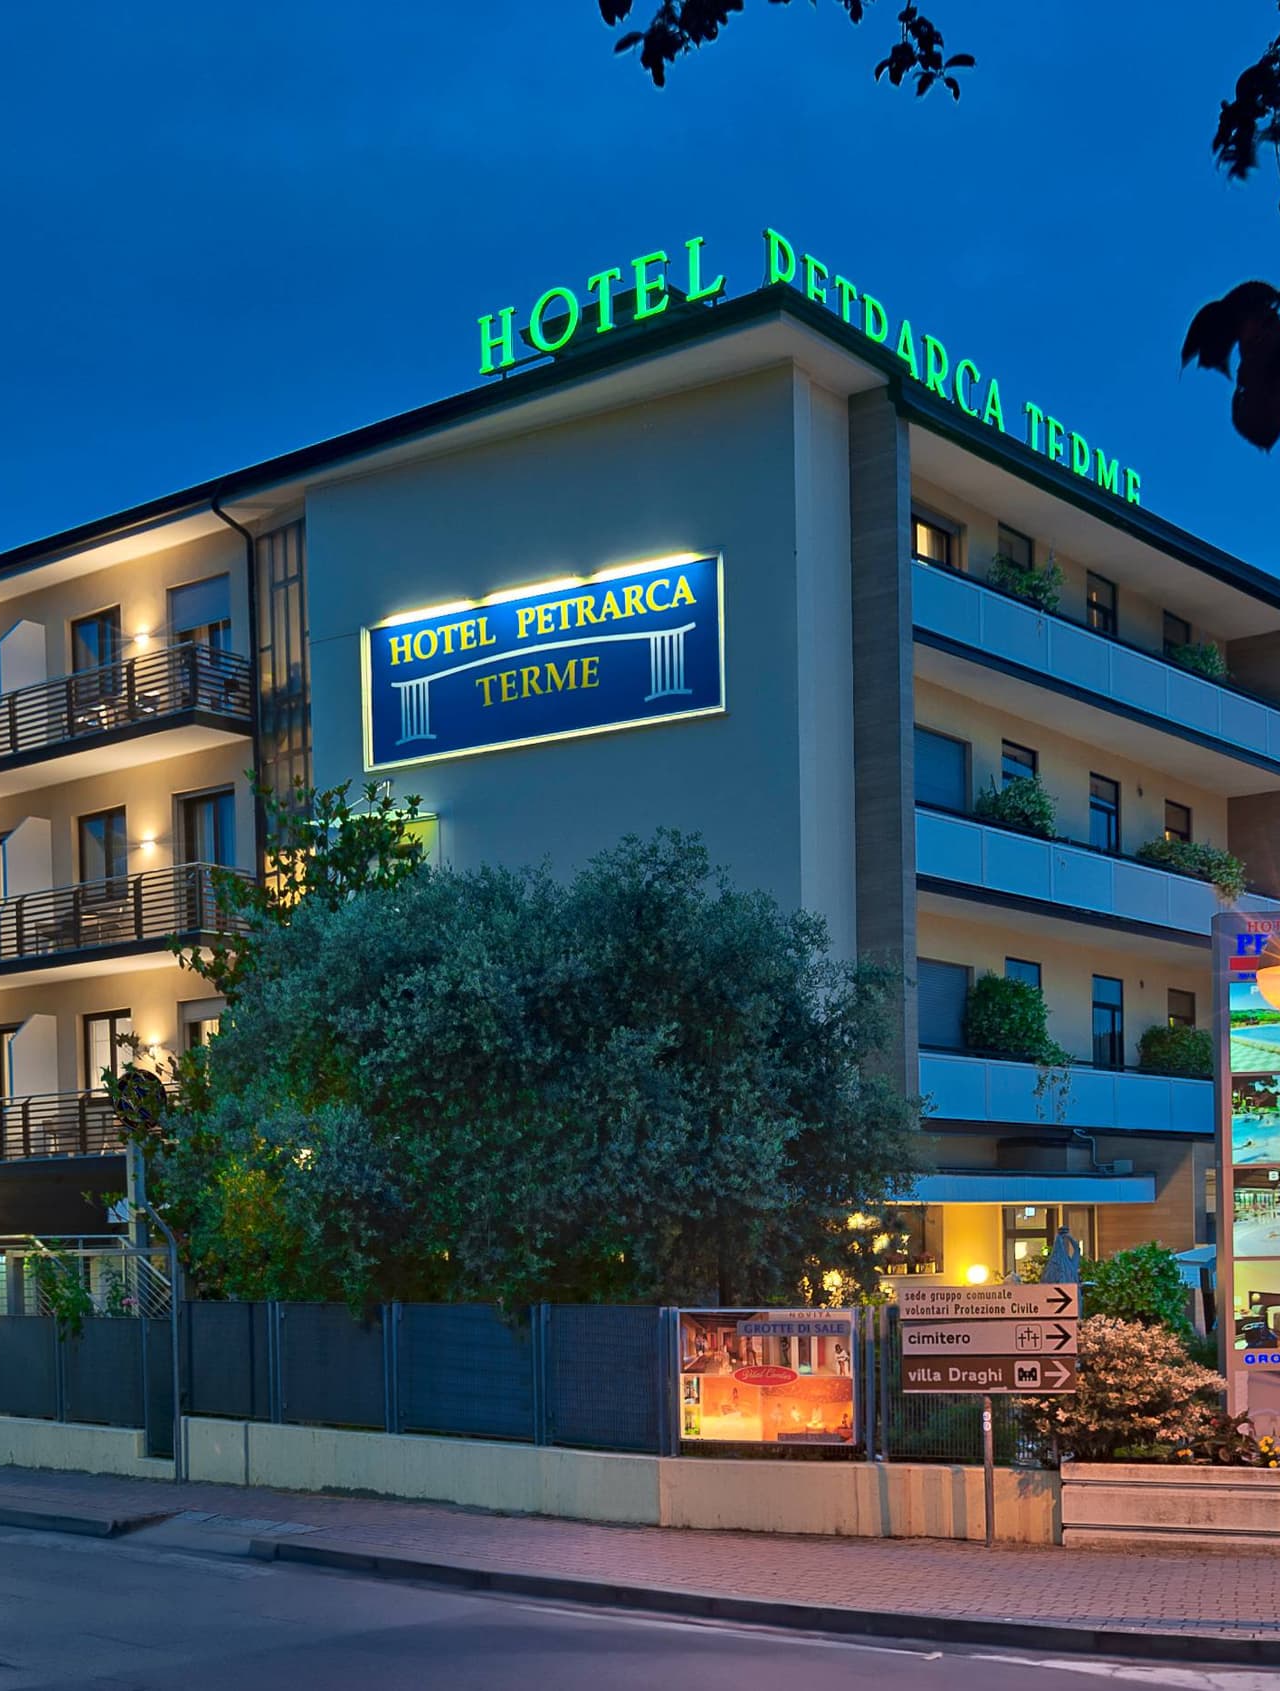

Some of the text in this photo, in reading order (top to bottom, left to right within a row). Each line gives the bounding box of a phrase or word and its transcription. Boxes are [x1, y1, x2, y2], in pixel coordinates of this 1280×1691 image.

[477, 236, 725, 375] HOTEL
[389, 575, 697, 666] HOTEL PETRARCA
[476, 656, 601, 707] TERME
[905, 1289, 1013, 1302] sede gruppo comunale
[905, 1302, 1039, 1315] volontari Protezione Civile
[744, 1323, 845, 1334] GROTTE DI SALE
[908, 1332, 971, 1345] cimitero
[908, 1367, 1003, 1385] villa Draghi
